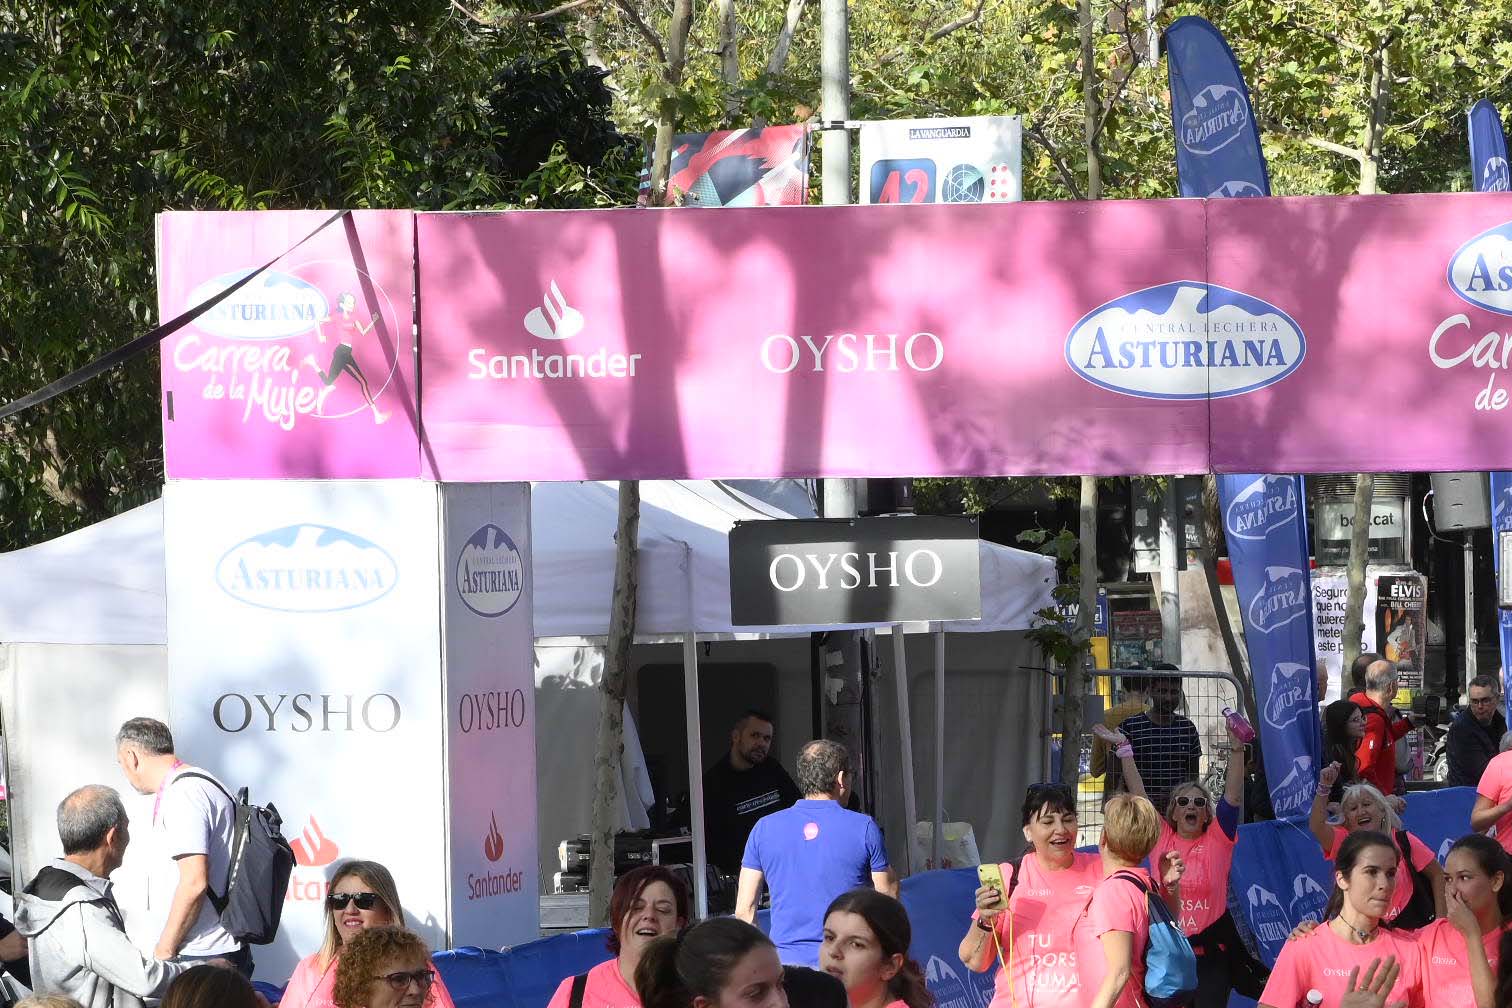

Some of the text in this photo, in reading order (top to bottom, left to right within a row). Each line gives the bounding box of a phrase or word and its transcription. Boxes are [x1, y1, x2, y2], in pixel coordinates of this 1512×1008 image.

[1203, 321, 1279, 333] LECHERA
[173, 335, 292, 373] Carrera
[467, 346, 642, 380] Santander
[760, 331, 945, 374] OYSHO
[1084, 327, 1288, 370] ASTURIANA
[203, 368, 337, 431] de la Mujer
[1474, 371, 1508, 411] de
[230, 555, 386, 592] ASTURIANA
[461, 562, 520, 596] ASTURIANA
[769, 549, 943, 592] OYSHO
[1316, 602, 1332, 613] que
[1390, 584, 1421, 597] ELVIS
[1318, 641, 1336, 651] este
[212, 692, 402, 734] OYSHO
[458, 688, 526, 734] OYSHO
[467, 866, 524, 900] Santander
[1028, 932, 1051, 949] TU
